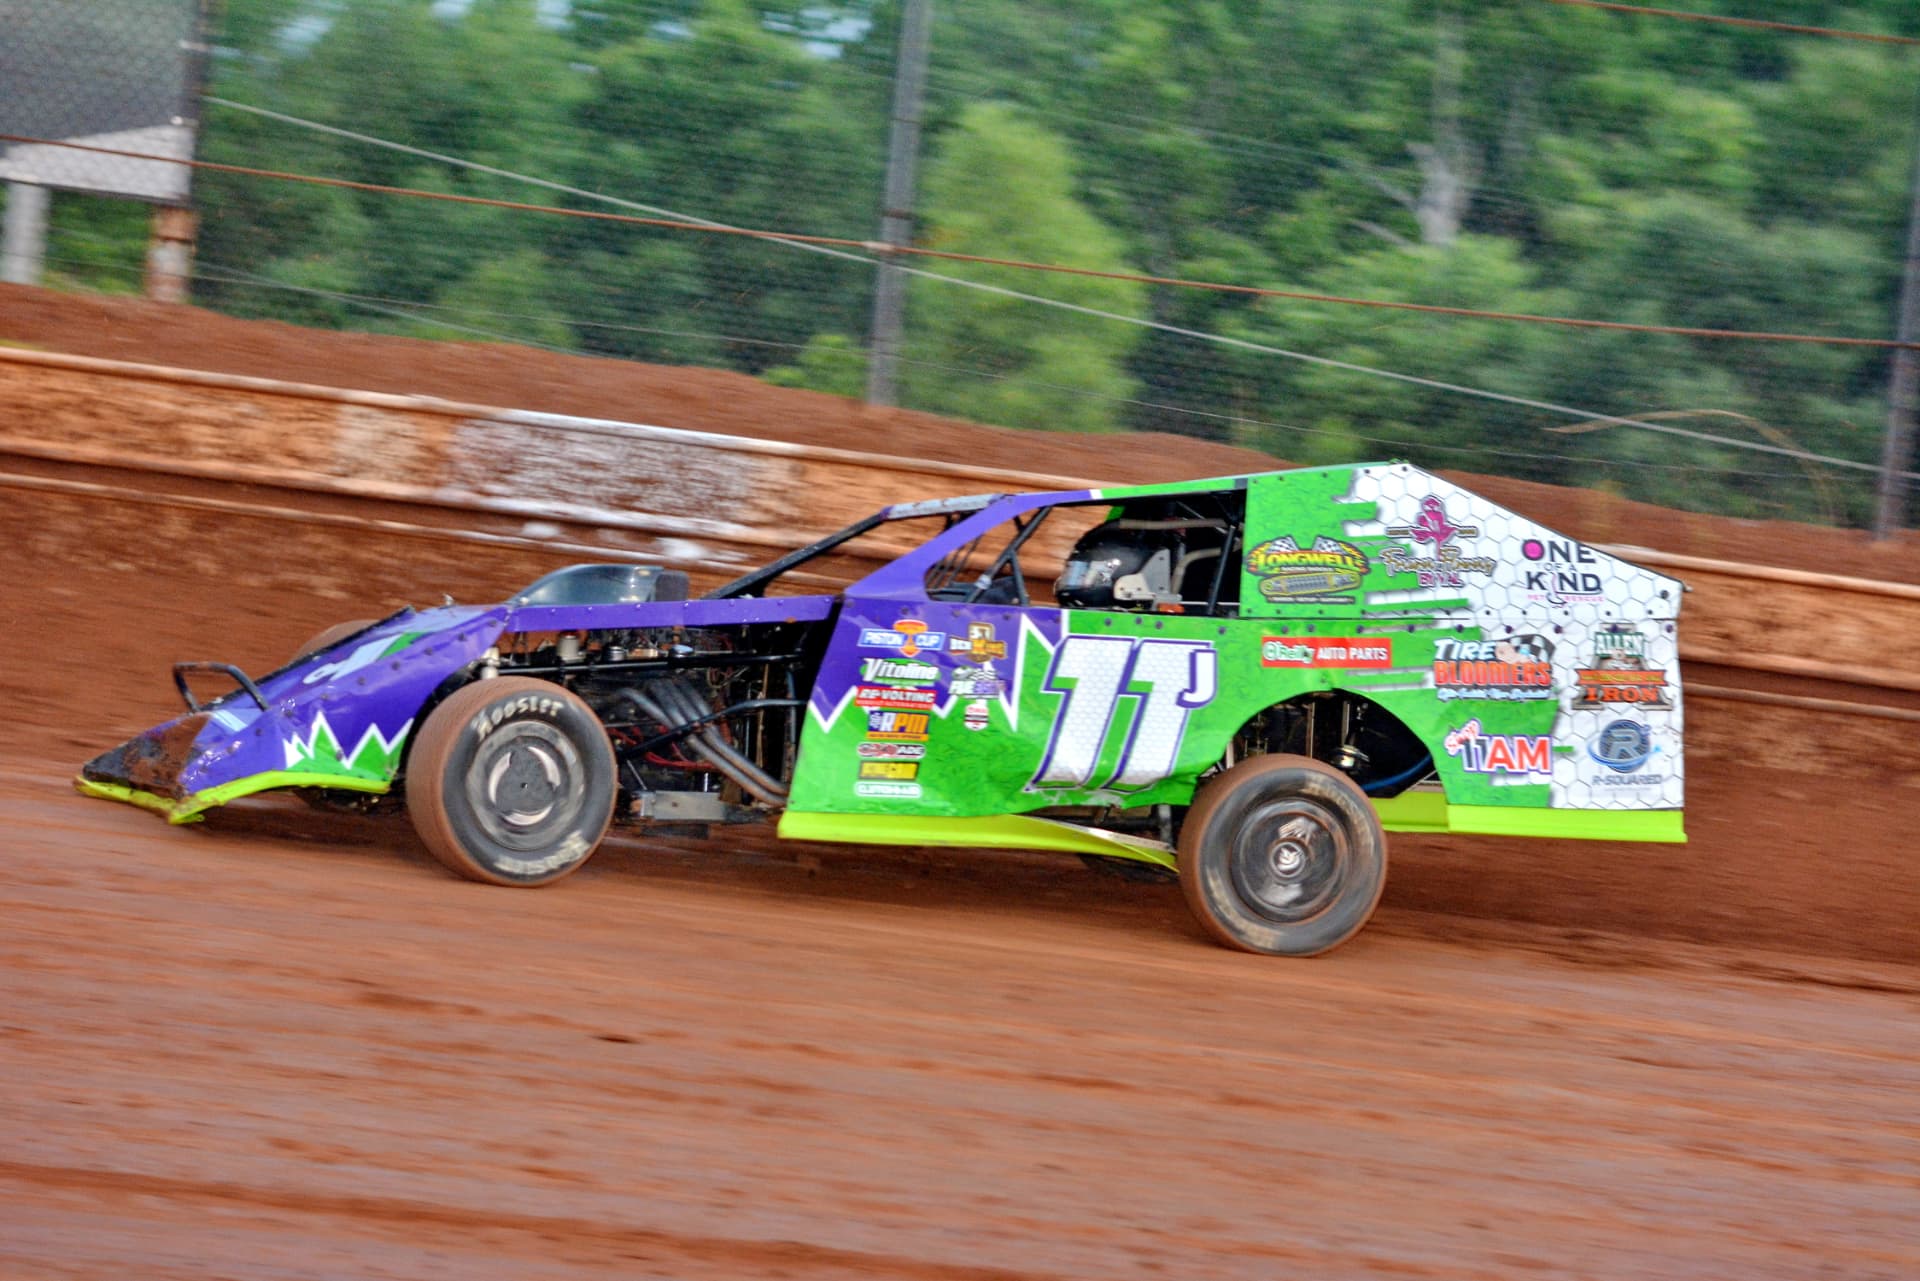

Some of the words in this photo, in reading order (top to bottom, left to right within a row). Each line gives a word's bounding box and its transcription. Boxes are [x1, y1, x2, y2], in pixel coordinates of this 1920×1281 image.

[1257, 551, 1357, 570] LONGWELL
[1522, 539, 1596, 563] ONE
[915, 633, 942, 648] CUP
[1433, 638, 1497, 660] TIRE
[1316, 647, 1347, 660] AUTO
[1348, 647, 1388, 660] PARTS
[1434, 660, 1552, 686] BLOOMERS
[1584, 686, 1659, 703] IRON
[880, 712, 929, 733] RPM
[1461, 734, 1552, 773] 11AM
